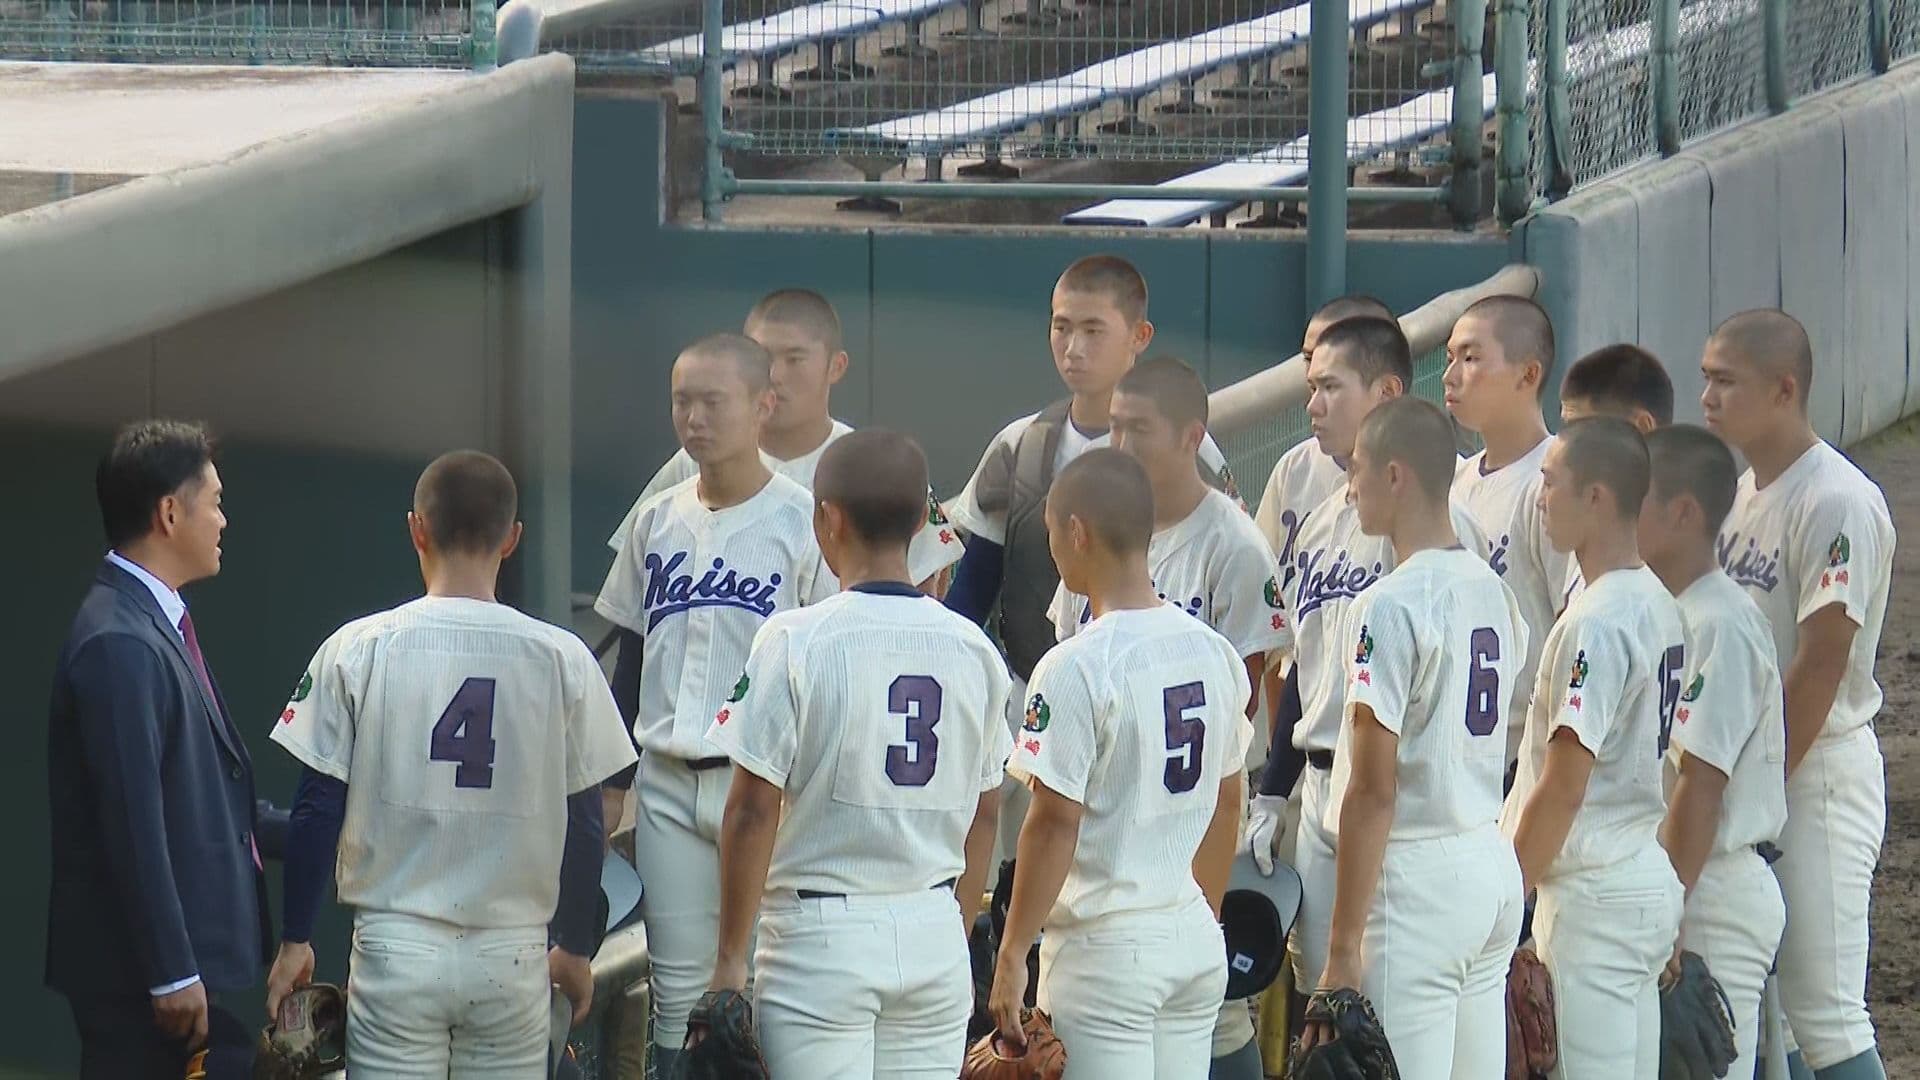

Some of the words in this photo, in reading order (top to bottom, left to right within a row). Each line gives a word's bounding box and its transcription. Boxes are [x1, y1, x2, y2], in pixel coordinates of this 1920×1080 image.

[644, 551, 782, 625] Kaisei
[430, 676, 496, 789] 4
[885, 674, 943, 787] 3
[1162, 680, 1207, 795] 5
[1464, 627, 1500, 737] 6
